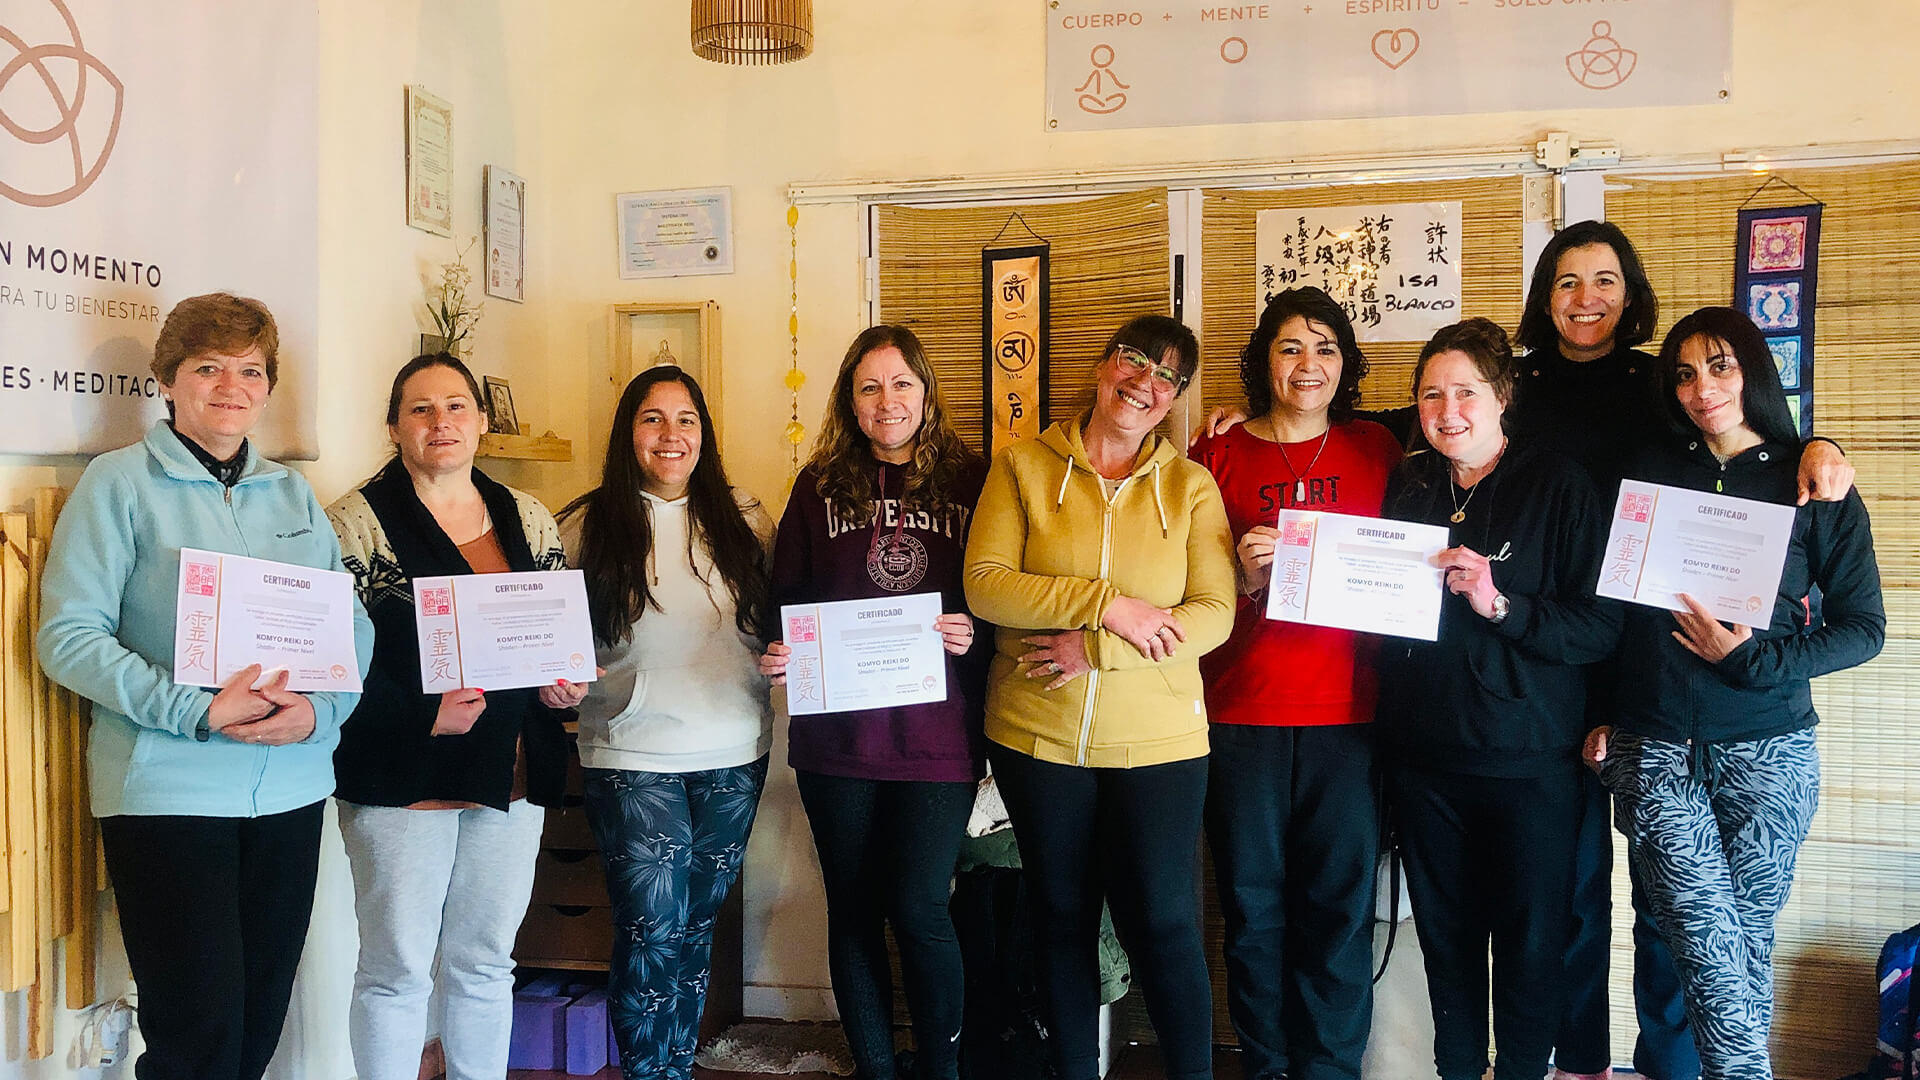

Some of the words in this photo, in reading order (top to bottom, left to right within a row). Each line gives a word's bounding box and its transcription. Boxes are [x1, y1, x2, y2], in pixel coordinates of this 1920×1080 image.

[1062, 12, 1143, 30] CUERPO
[1200, 5, 1269, 22] MENTE
[27, 244, 161, 288] MOMENTO
[1399, 273, 1438, 288] ISA
[0, 286, 25, 307] RA
[34, 290, 57, 311] TU
[65, 294, 160, 324] BIENESTAR
[1385, 294, 1455, 312] BLANCO
[3, 366, 31, 389] ES
[1258, 475, 1341, 512] START
[1697, 505, 1748, 521] CERTIFICADO
[824, 497, 968, 550] UNVERSITY
[1357, 527, 1406, 541] CERTIFICADO
[1683, 558, 1710, 569] KOMYO
[1711, 564, 1729, 573] REIKI
[263, 574, 311, 590] CERTIFICADO
[495, 583, 544, 593] CERTIFICADO
[1346, 578, 1373, 587] KOMYO
[857, 608, 903, 620] CERTIFICADO
[256, 633, 283, 643] KOMYO
[283, 637, 302, 645] REIKI
[496, 635, 523, 644] KOMYO
[857, 660, 882, 668] KOMYO
